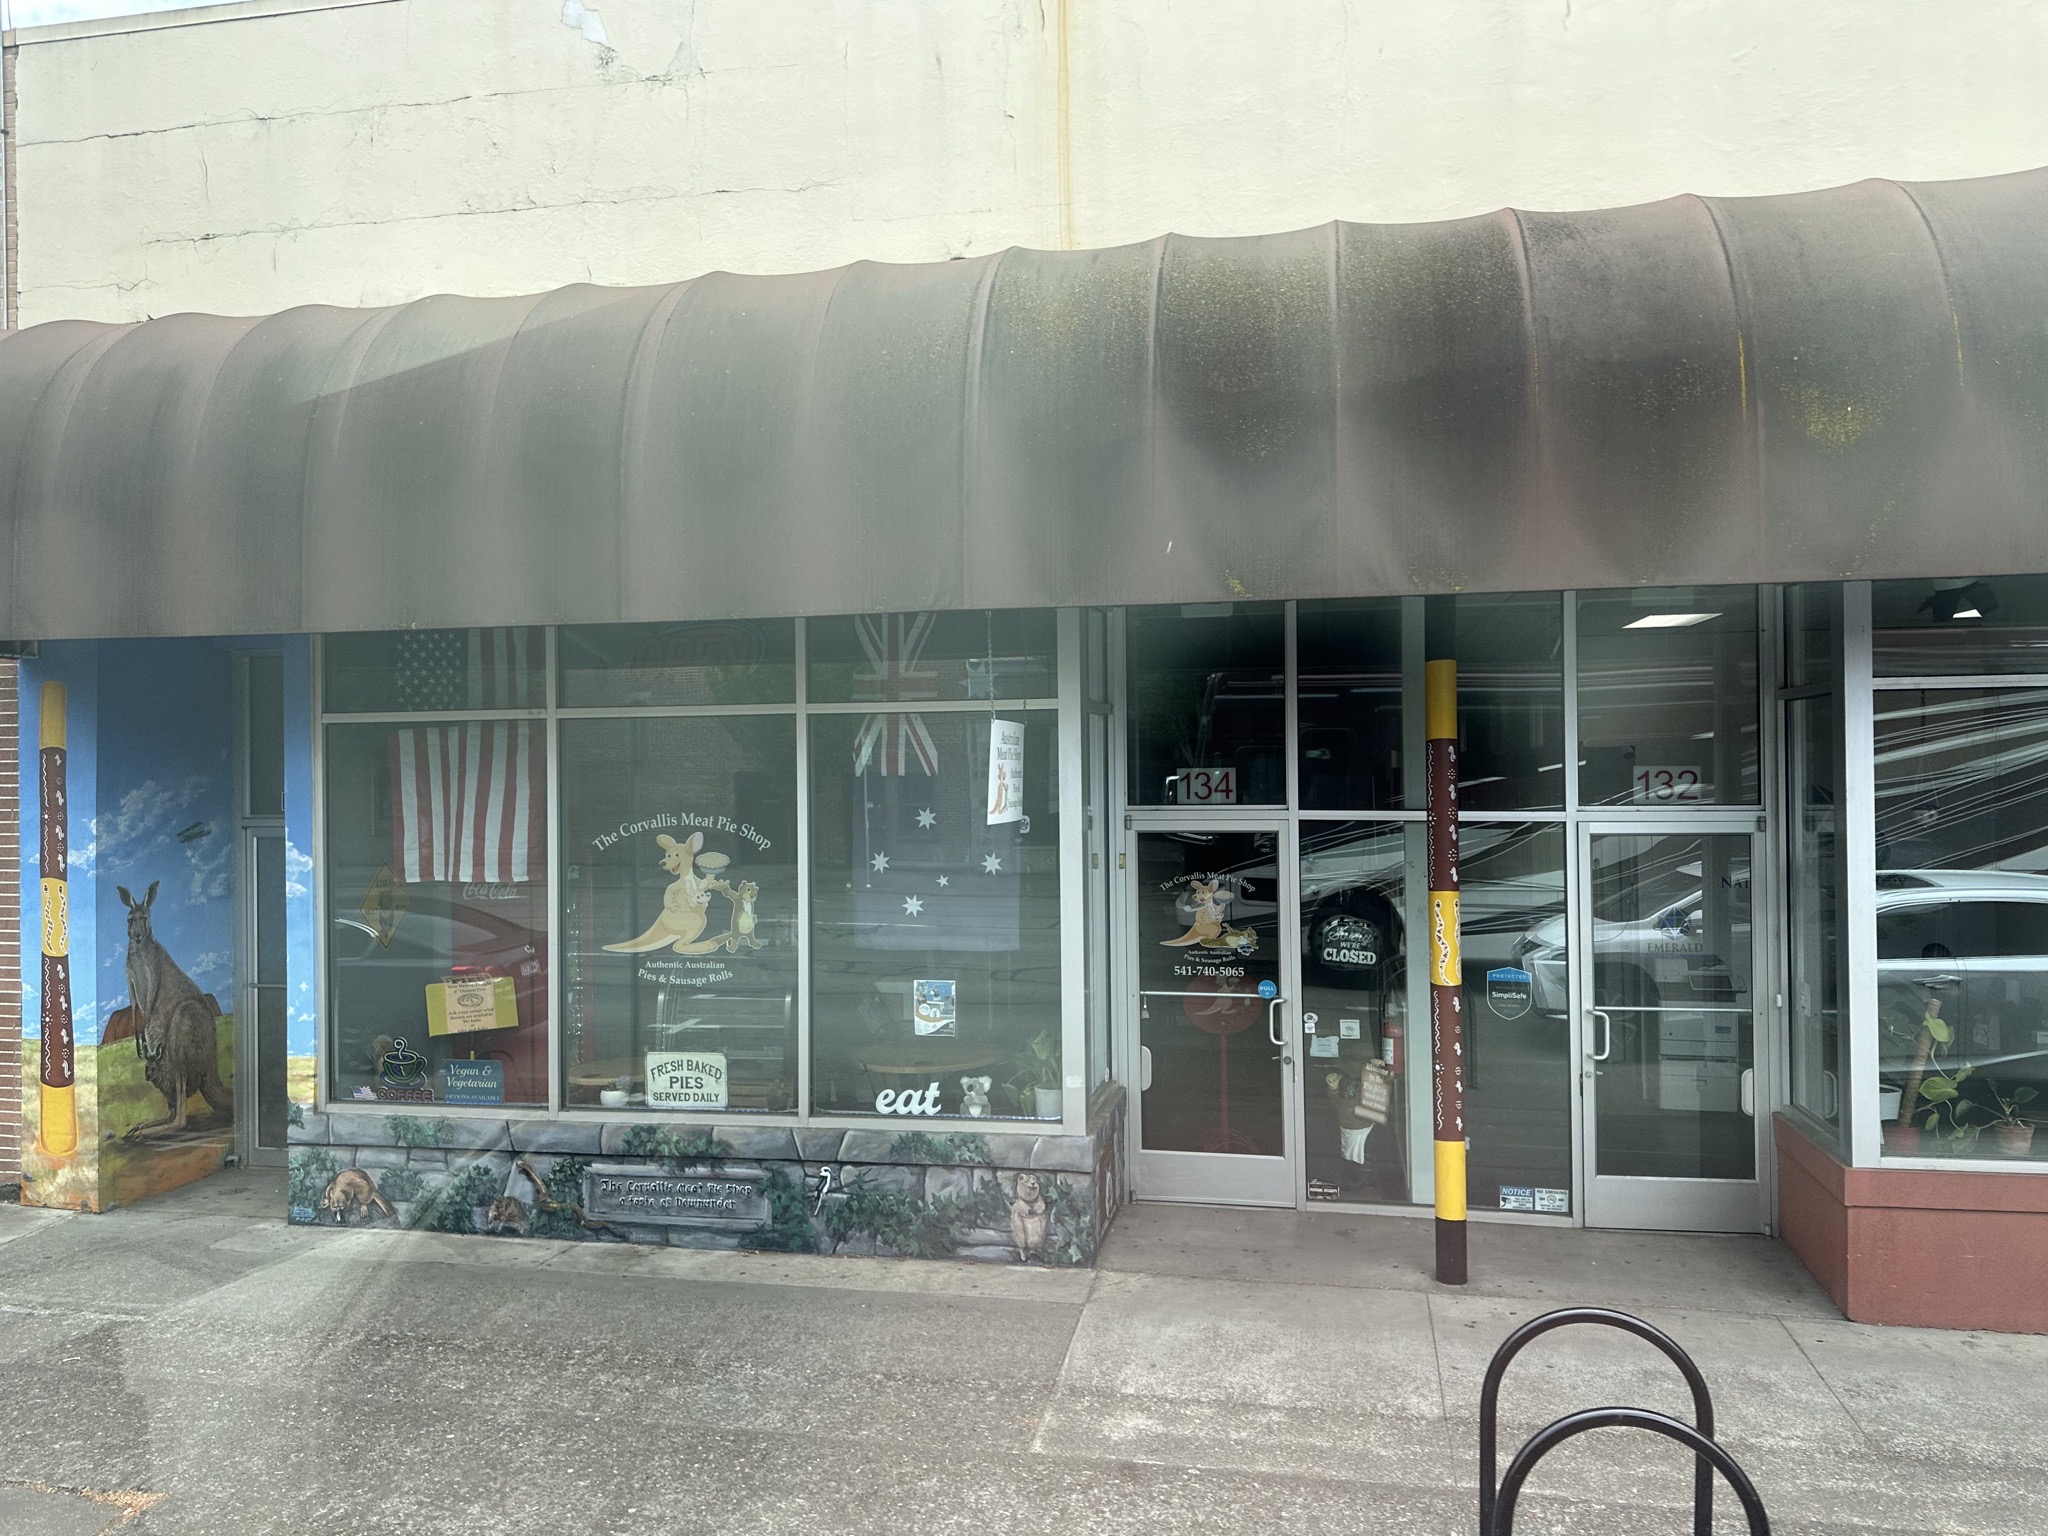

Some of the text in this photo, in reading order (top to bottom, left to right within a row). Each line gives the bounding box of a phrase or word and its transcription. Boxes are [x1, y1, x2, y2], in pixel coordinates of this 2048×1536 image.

[1179, 771, 1234, 800] 134
[1637, 769, 1699, 801] 132
[592, 812, 772, 851] The Corvallis Meat Pie Shop
[1159, 871, 1257, 893] The Corvallis Meat Pie Shop
[1340, 941, 1361, 949] WE'RE
[1647, 942, 1703, 953] EMERALD
[1183, 953, 1196, 962] Pies
[1201, 956, 1222, 965] Sausage
[1323, 947, 1377, 965] CLOSED
[645, 960, 726, 969] Authentic Australian
[1173, 965, 1245, 977] 541-740-5065
[637, 968, 734, 988] Pies & Sausage Rolls
[1491, 991, 1527, 1000] SimpliSafe
[450, 1064, 493, 1076] Vegan &
[650, 1059, 722, 1082] FRESH BAKED
[446, 1076, 497, 1089] Vegetarian
[669, 1076, 704, 1089] PIES
[377, 1087, 433, 1102] COFFEE
[653, 1092, 720, 1103] SERVED DAILY
[875, 1081, 942, 1116] eat
[600, 1179, 623, 1192] The
[626, 1180, 674, 1194] Corvallis
[676, 1182, 704, 1195] Meat
[725, 1184, 753, 1197] Shop
[1501, 1187, 1532, 1197] NOTICE
[619, 1197, 626, 1206] a
[628, 1195, 655, 1207] taste
[674, 1196, 737, 1210] Downunder
